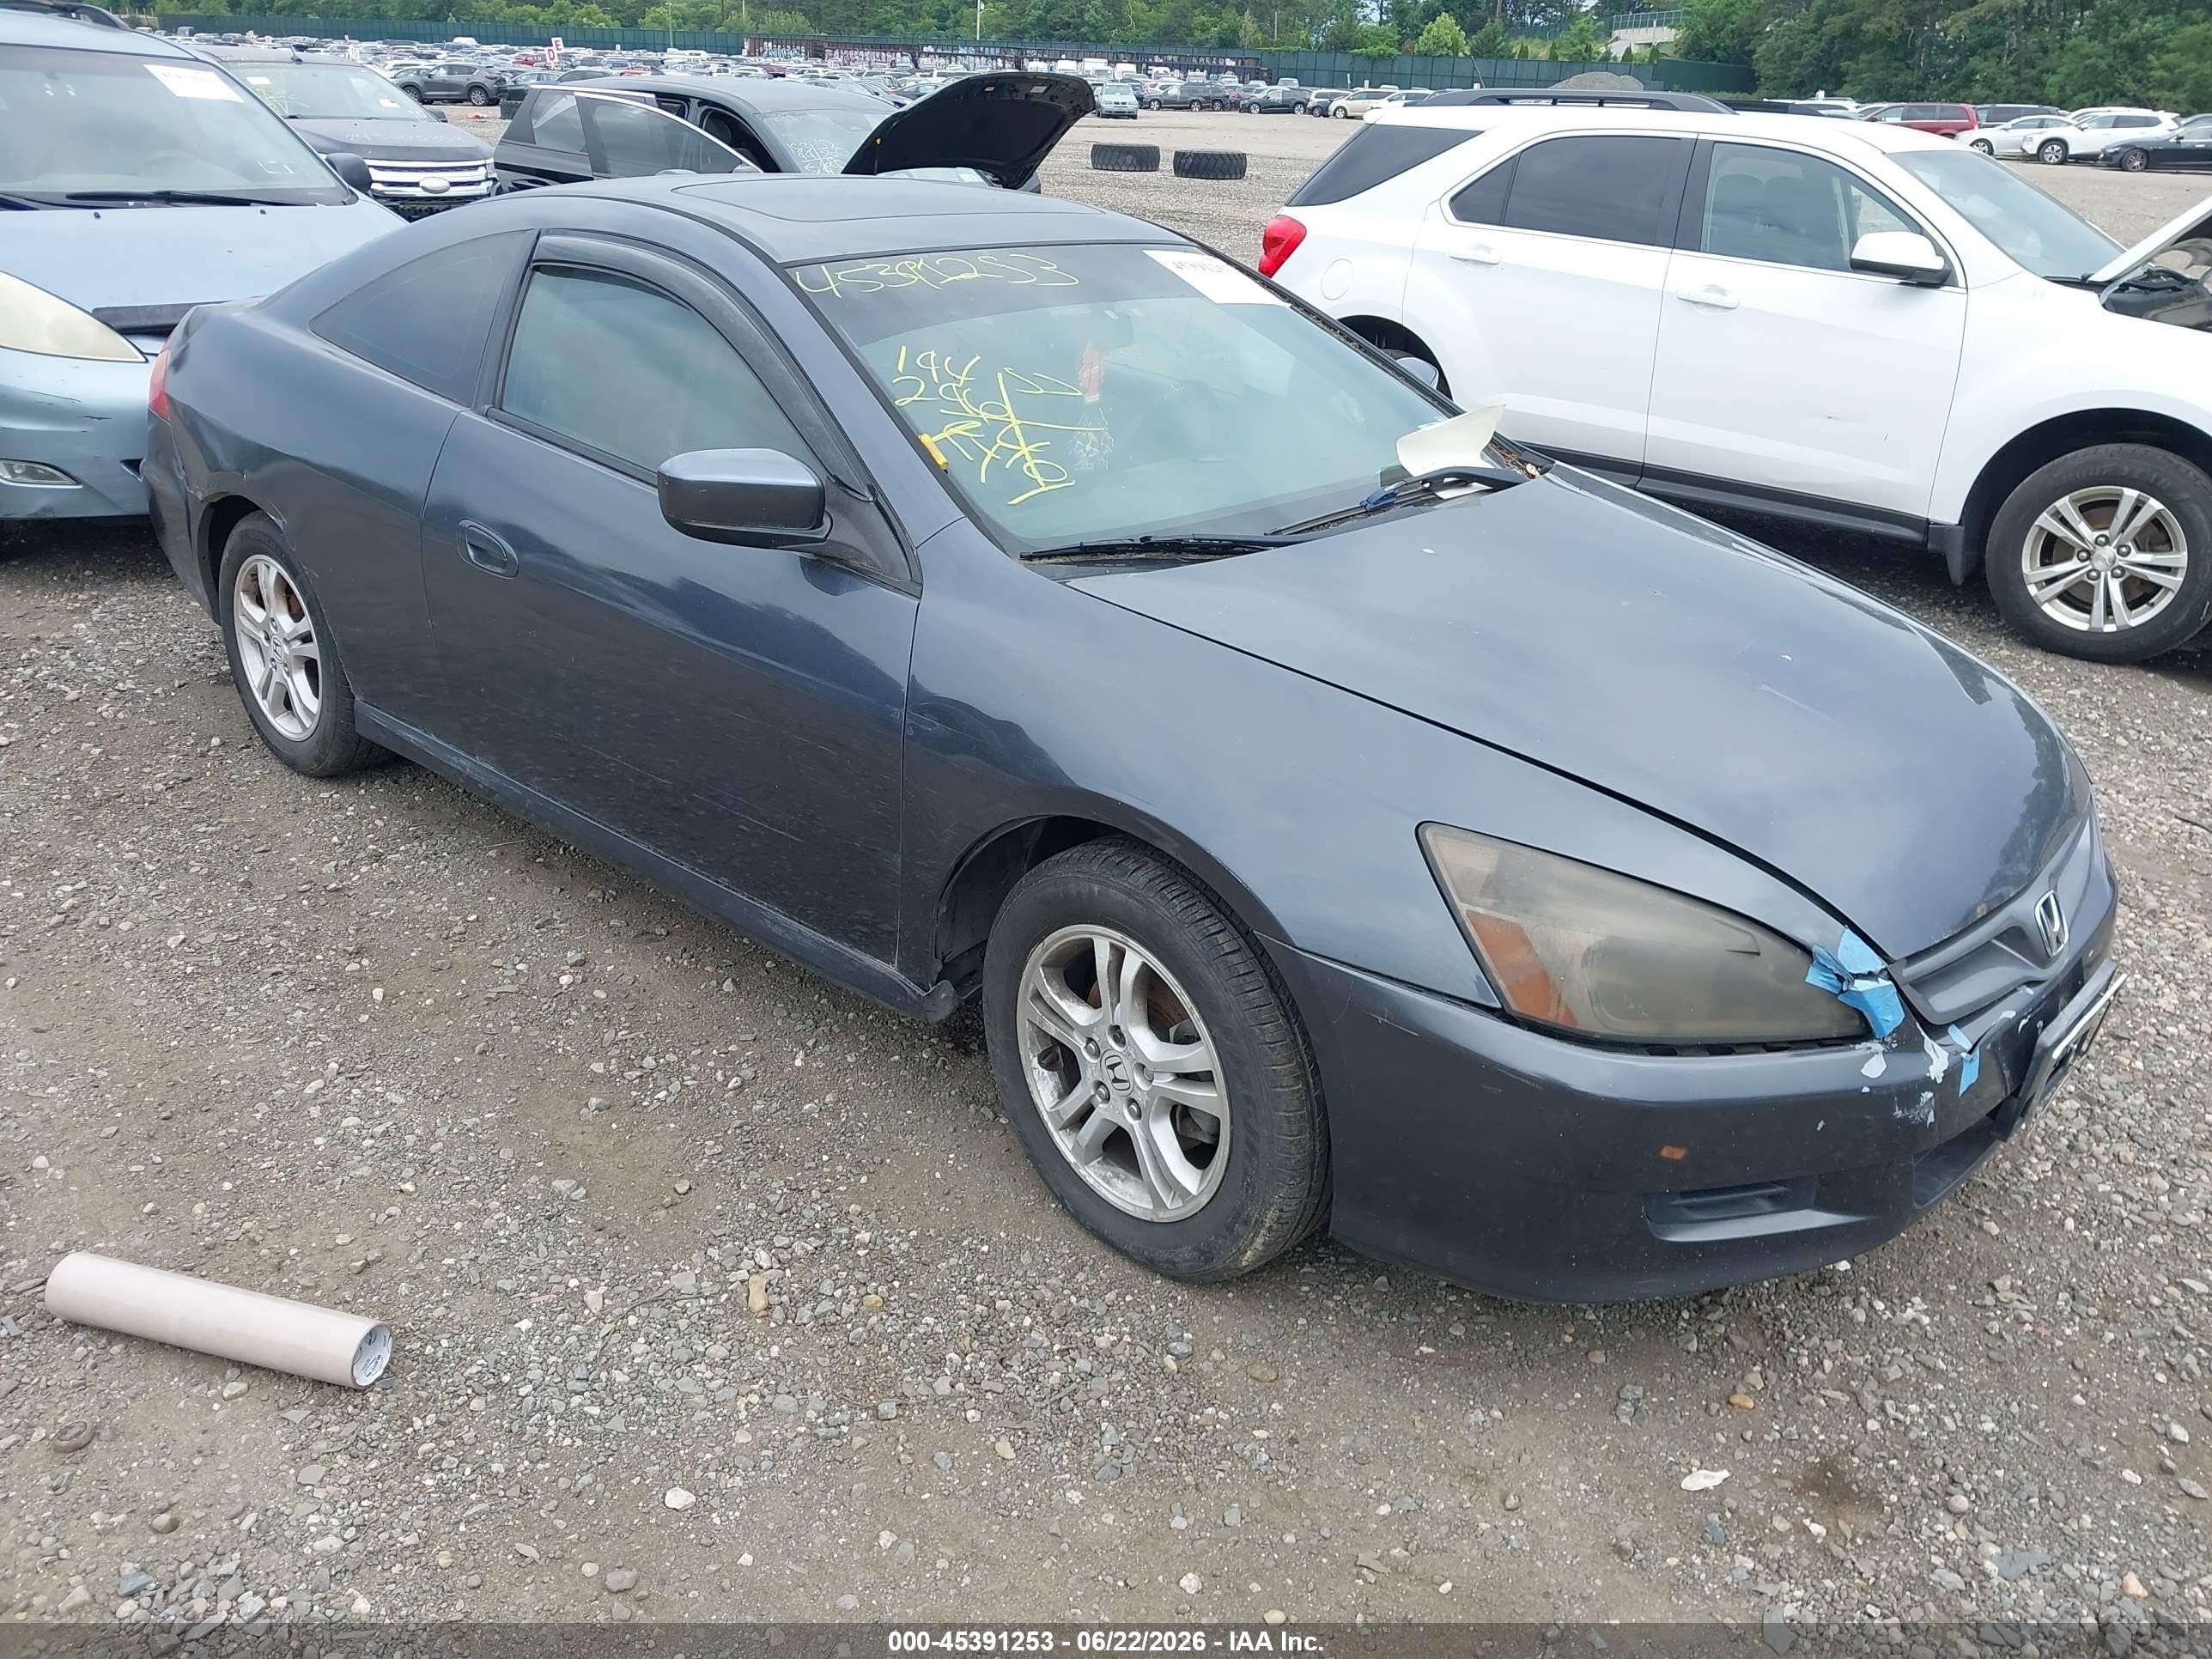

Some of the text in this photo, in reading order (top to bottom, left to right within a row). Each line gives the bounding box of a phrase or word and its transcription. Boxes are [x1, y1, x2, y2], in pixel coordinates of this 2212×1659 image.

[555, 40, 562, 51] E
[548, 49, 555, 60] D
[795, 253, 1079, 299] 45391253
